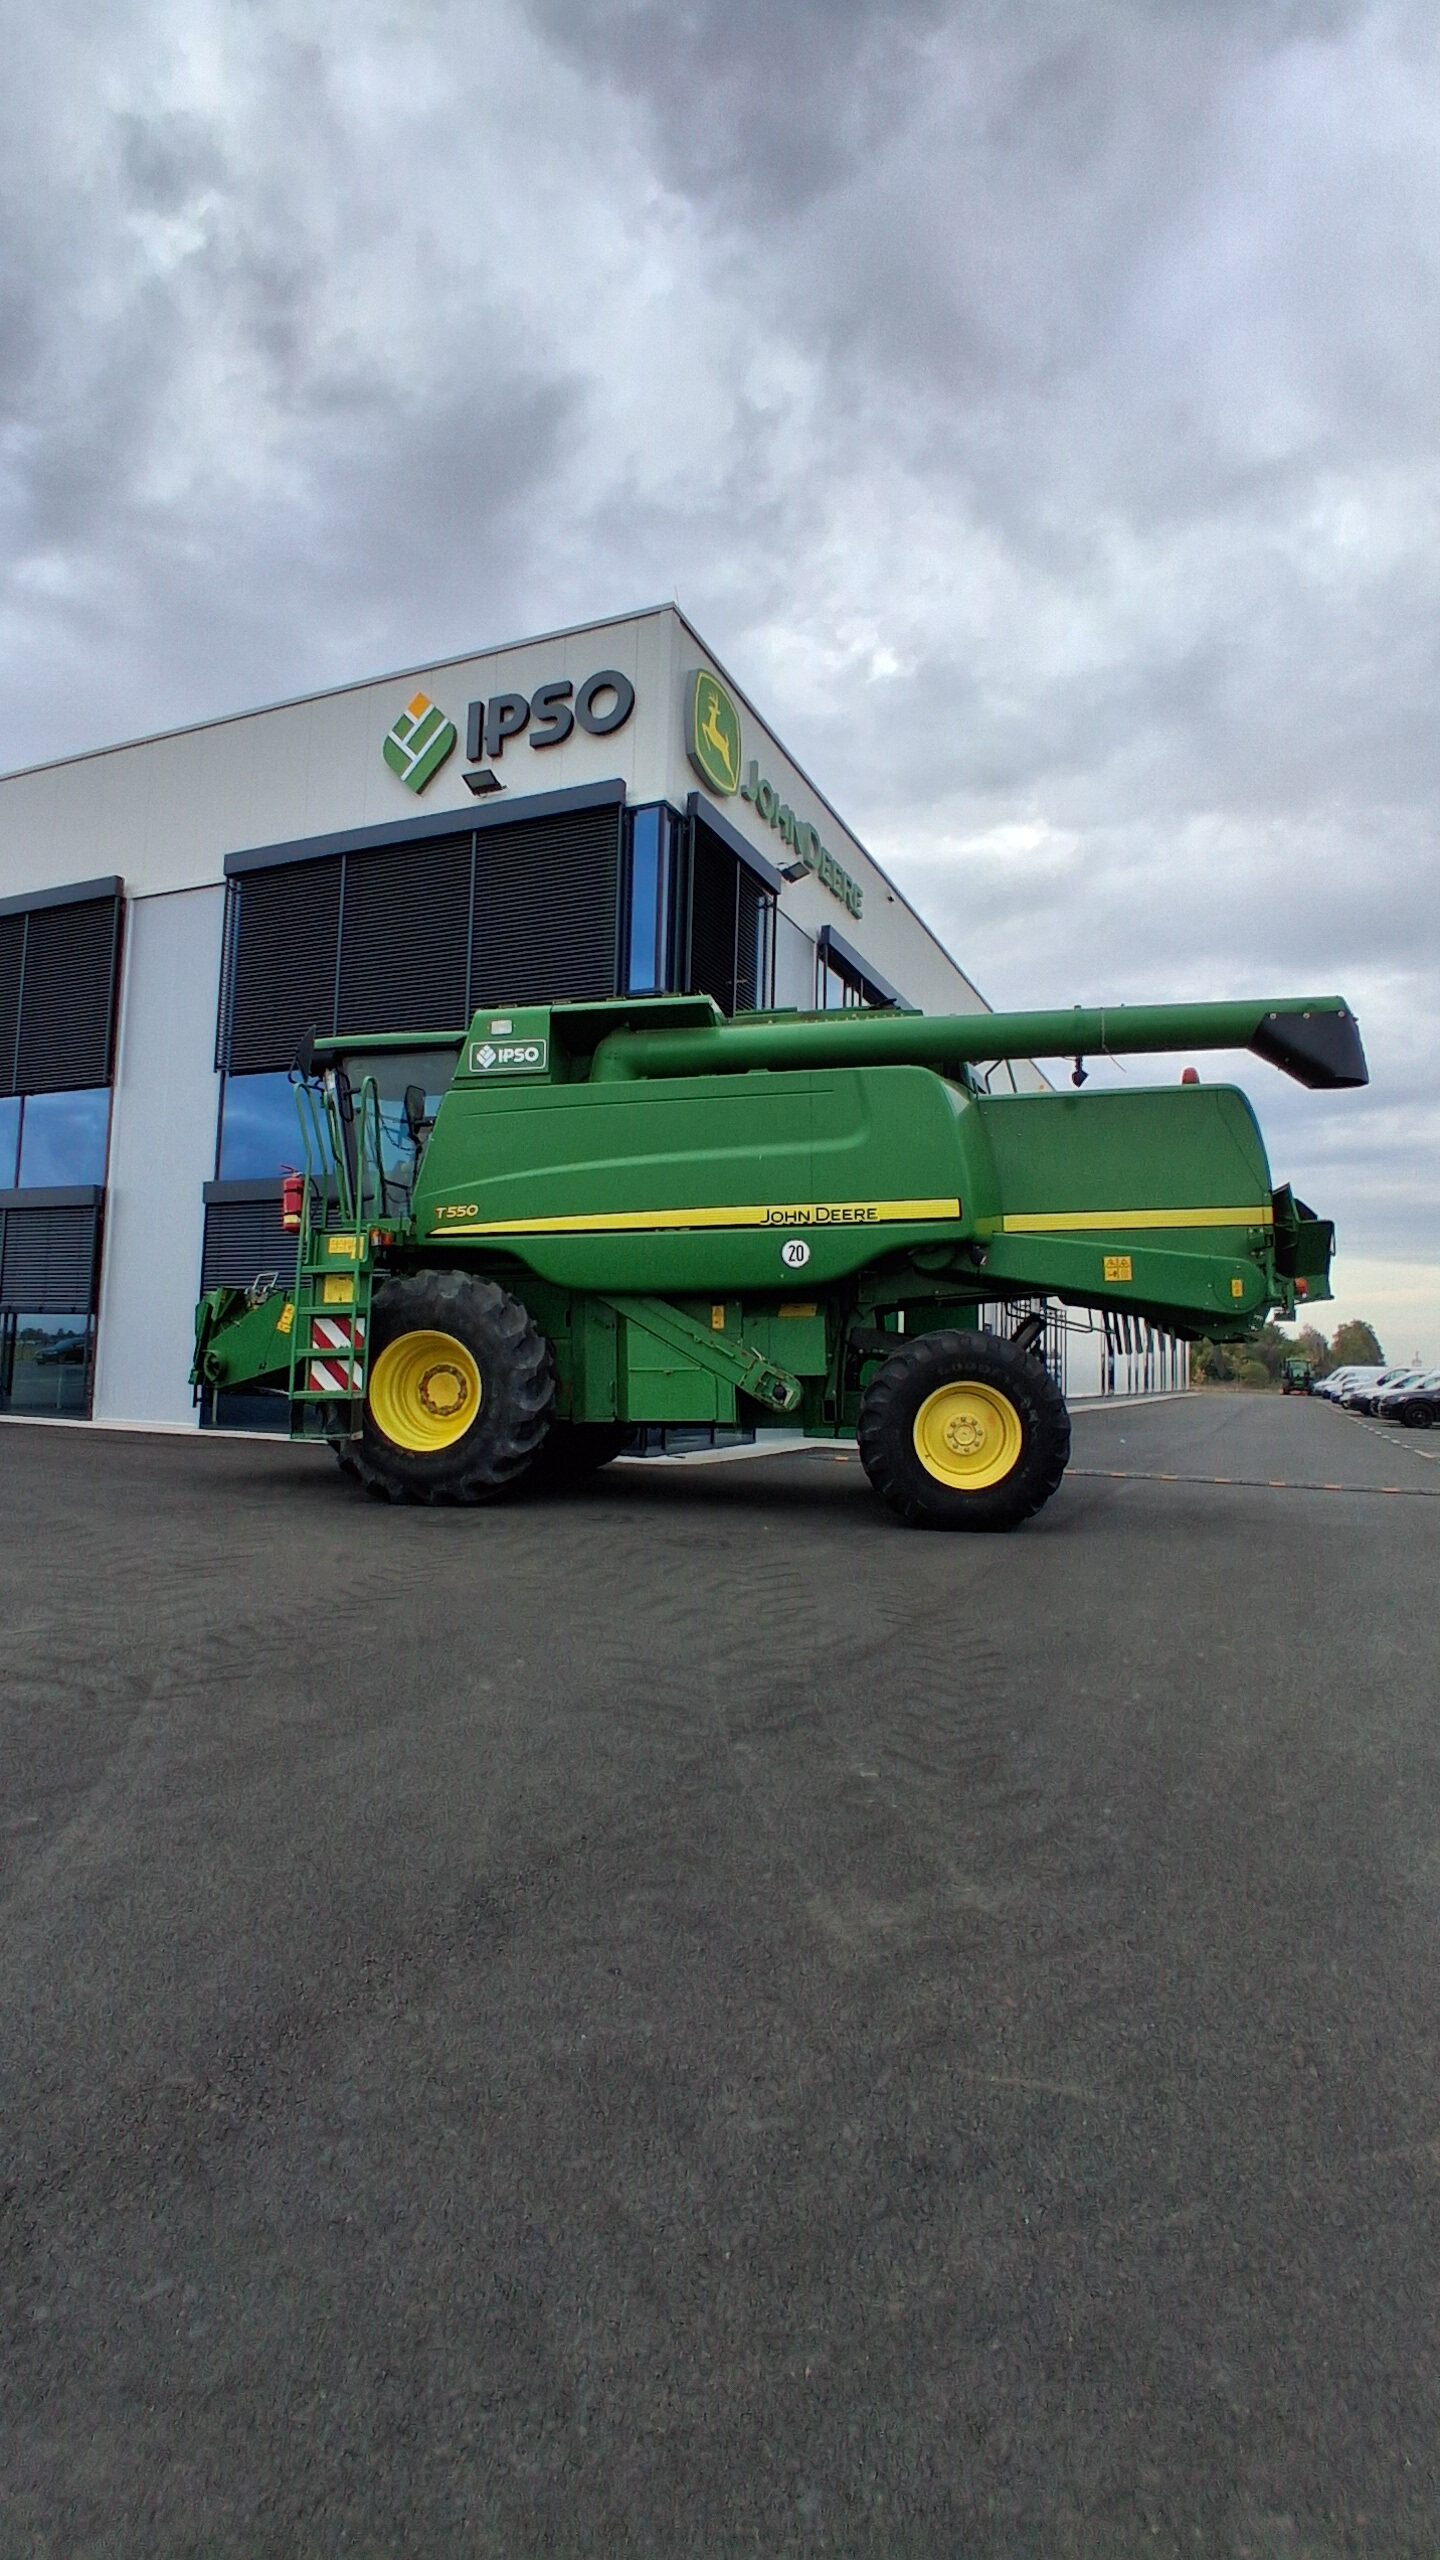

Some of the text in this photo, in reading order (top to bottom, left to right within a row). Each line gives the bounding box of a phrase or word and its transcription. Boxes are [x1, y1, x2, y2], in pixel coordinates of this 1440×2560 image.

[467, 670, 635, 762] IPSO
[741, 760, 863, 919] JOHN DEERE
[498, 1046, 539, 1063] IPSO
[435, 1204, 479, 1219] T550
[760, 1207, 878, 1224] JOHN DEERE
[788, 1244, 804, 1262] 20
